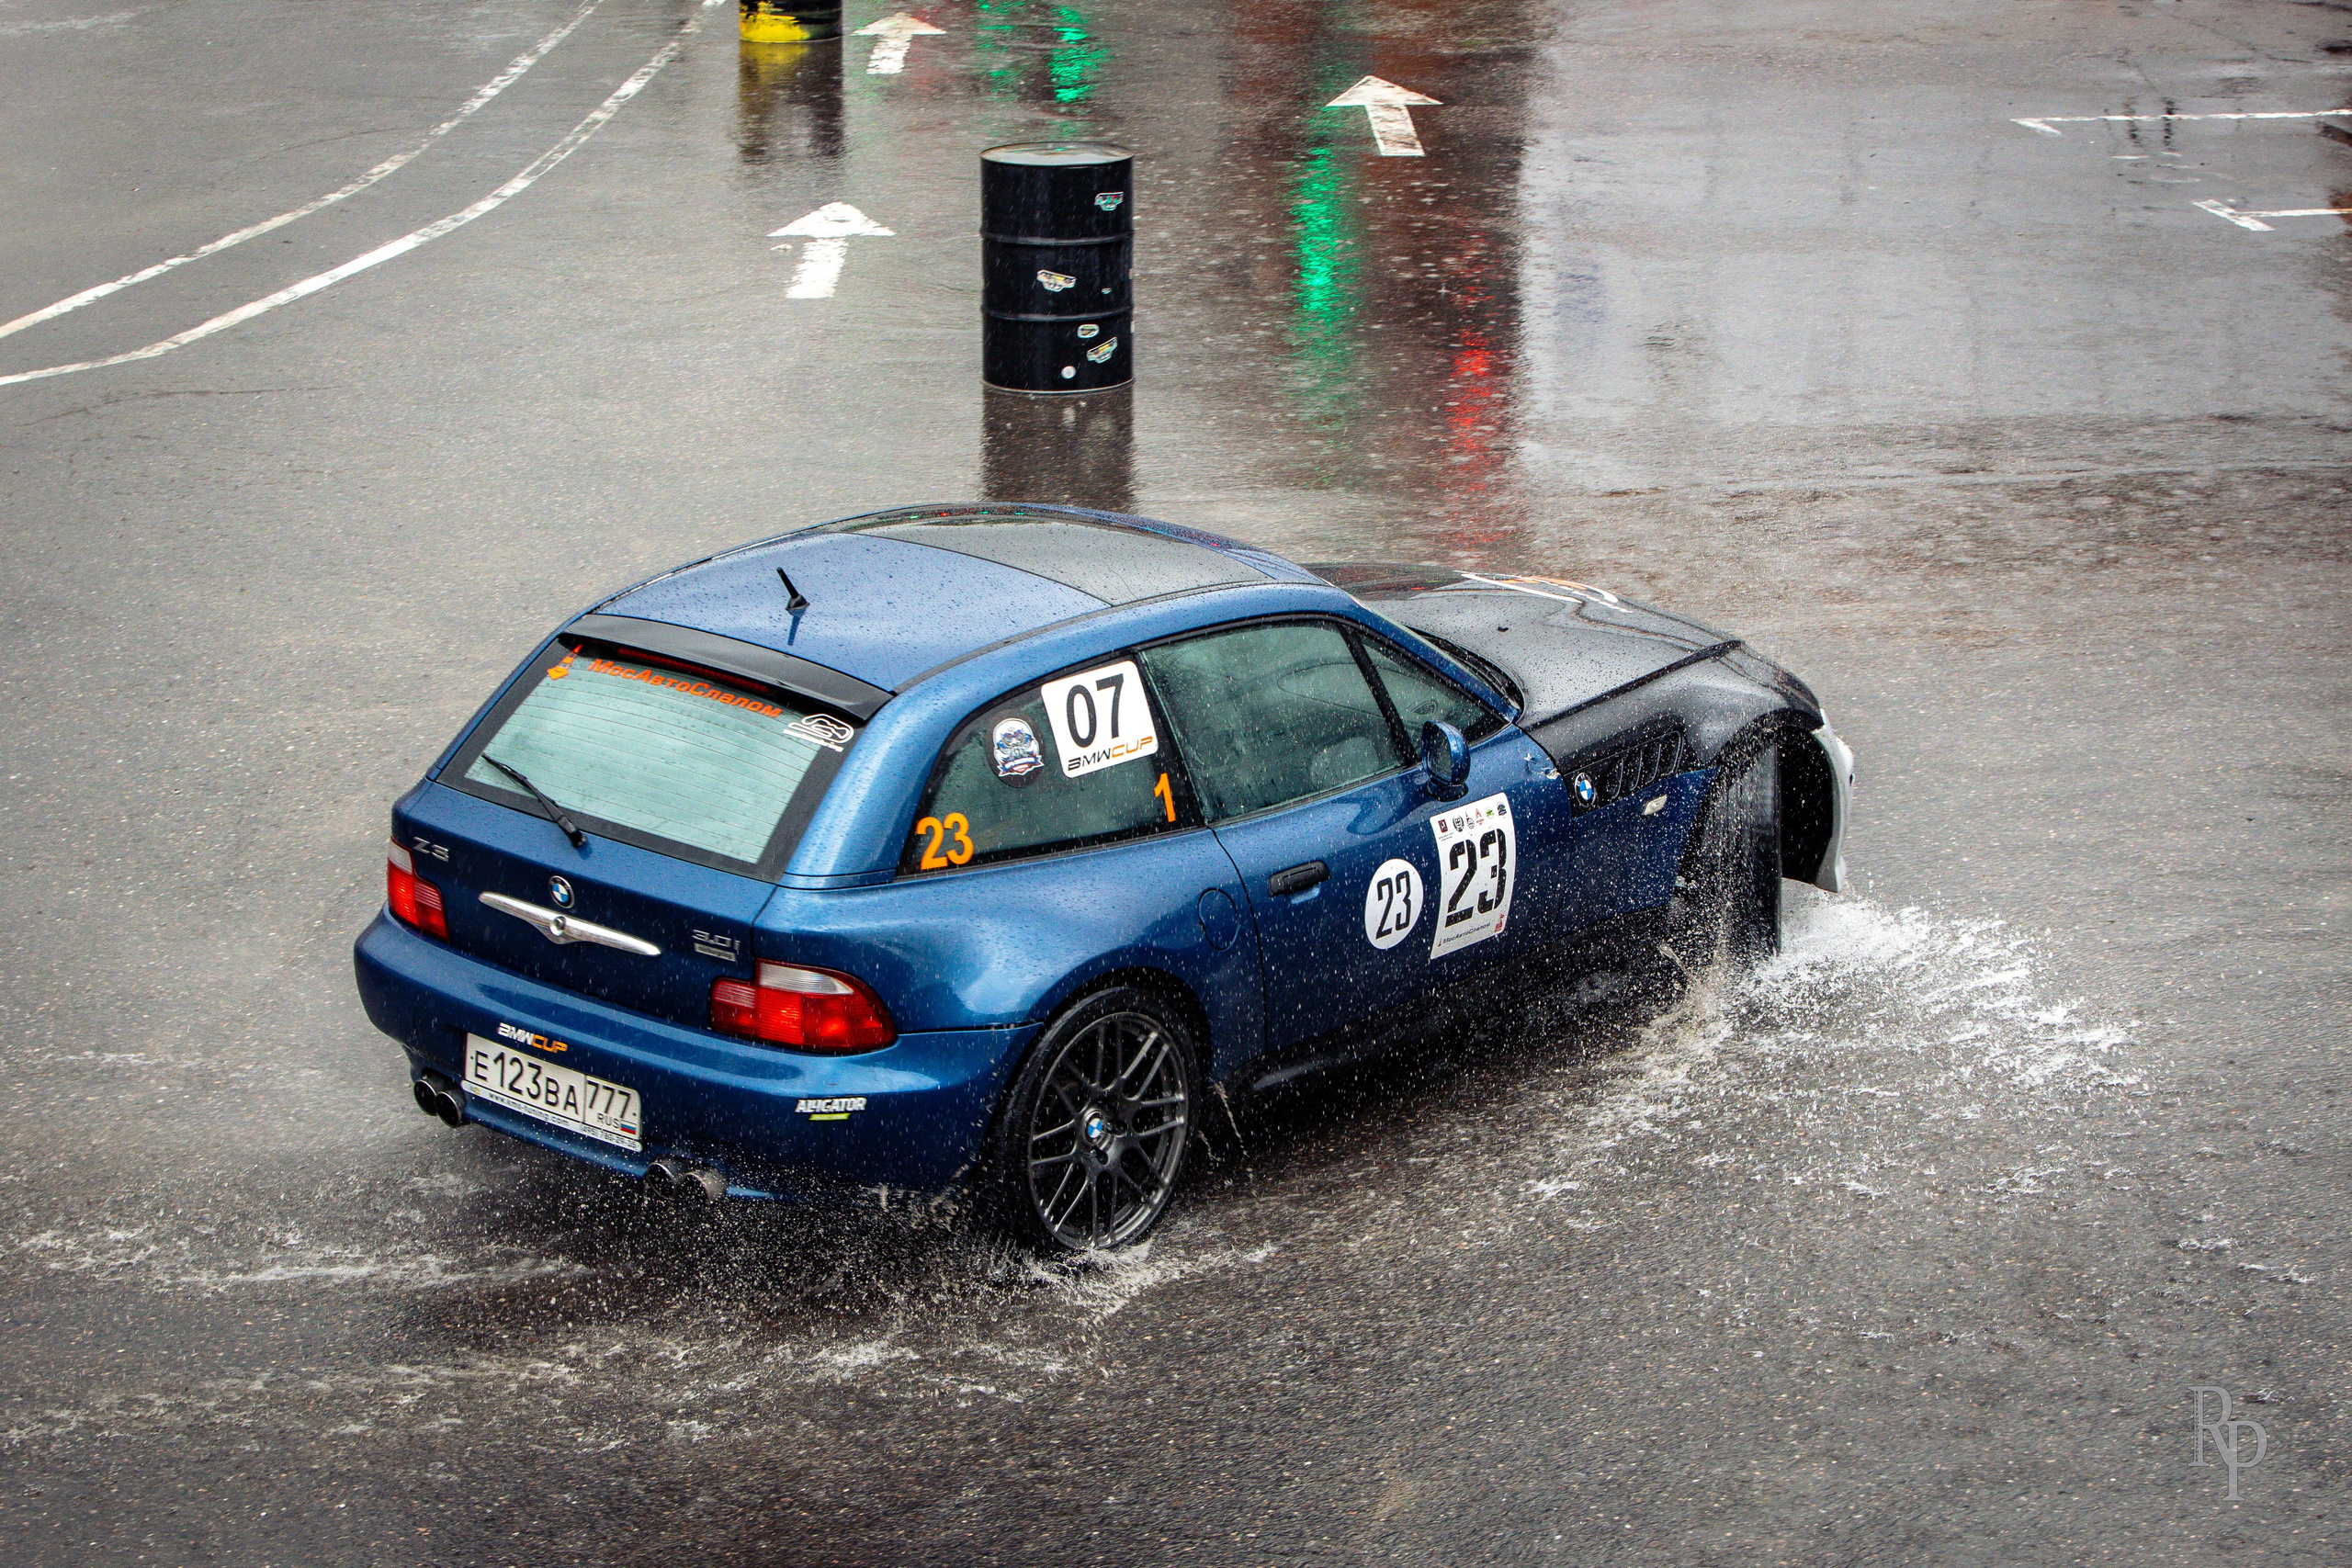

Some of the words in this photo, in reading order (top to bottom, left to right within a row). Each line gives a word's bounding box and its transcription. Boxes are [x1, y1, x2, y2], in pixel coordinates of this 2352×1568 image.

[587, 658, 782, 718] МосАвтоСлалом
[1066, 673, 1125, 749] 07
[1153, 773, 1176, 822] 1
[413, 836, 449, 863] Z3
[916, 812, 974, 870] 23
[1375, 870, 1411, 940] 23
[1445, 829, 1507, 928] 23
[586, 1079, 631, 1119] 777
[597, 1112, 621, 1129] RUS
